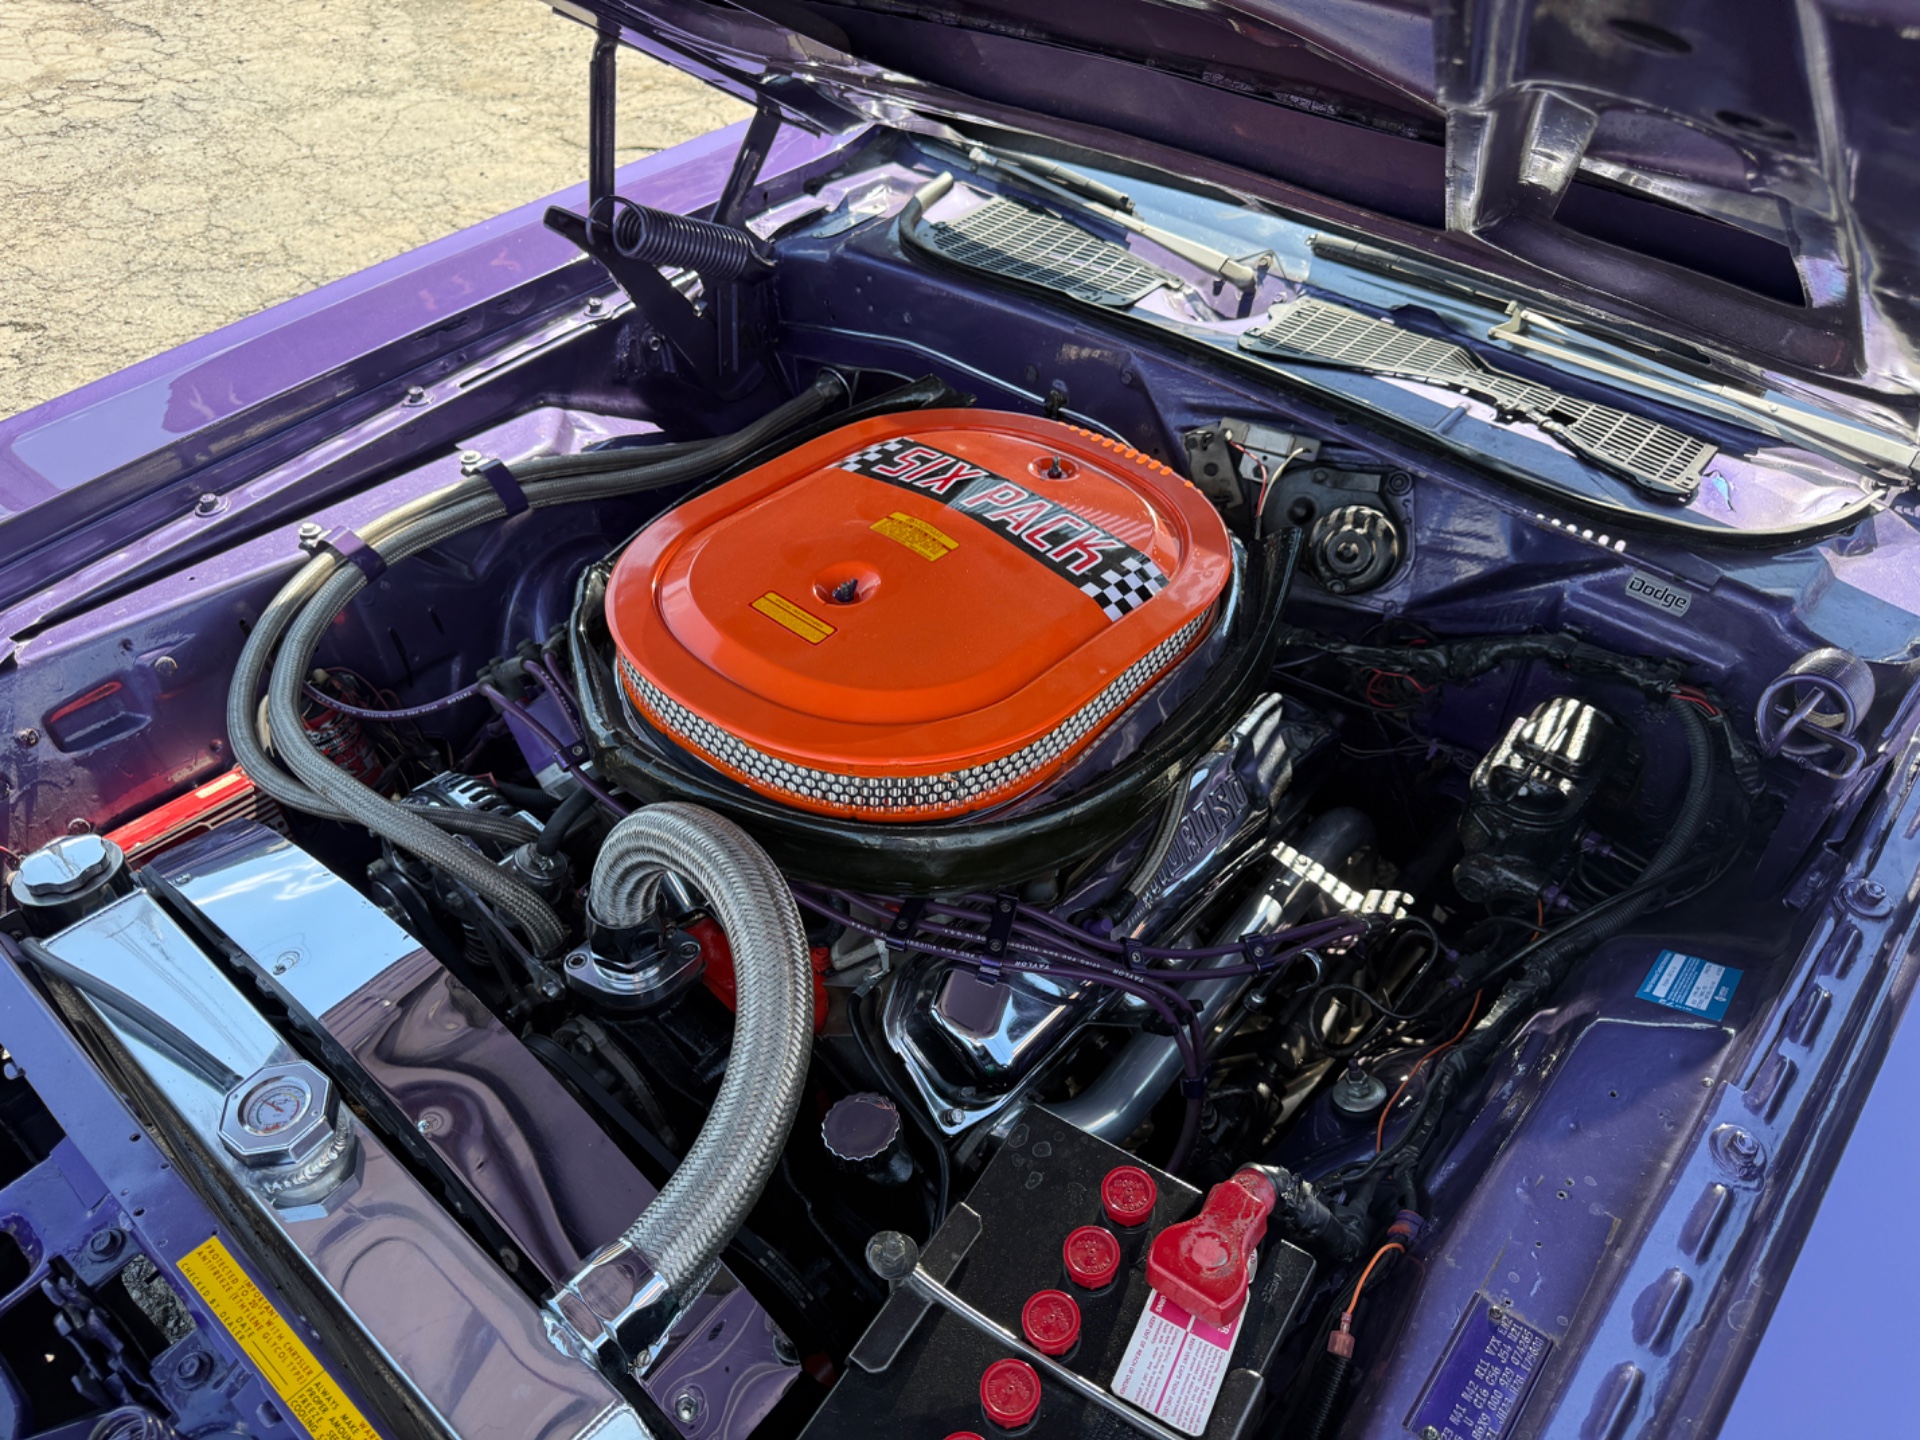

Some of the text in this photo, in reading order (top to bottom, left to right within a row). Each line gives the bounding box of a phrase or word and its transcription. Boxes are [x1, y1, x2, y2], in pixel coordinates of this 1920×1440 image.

[876, 446, 988, 494] SIX
[960, 482, 1115, 576] PACK
[1628, 576, 1686, 608] Dodge
[1014, 957, 1050, 972] TAYLOR
[1111, 968, 1144, 983] TAYLOR
[179, 1261, 246, 1342] CHECKED BY DEALER
[194, 1249, 307, 1385] ANTIFREEZE (ETHYLENE GLYCOL TYPE)
[203, 1243, 240, 1285] PROTECTED
[264, 1318, 285, 1342] WITH
[281, 1341, 314, 1377] CHRYSLER
[241, 1278, 279, 1321] IMPORTANT
[234, 1315, 255, 1338] DATE
[1483, 1335, 1503, 1357] V7X
[288, 1398, 319, 1433] COOLING
[295, 1392, 327, 1427] FREEZE.
[304, 1386, 329, 1414] PROPER
[312, 1380, 360, 1435] ALWAYS MAKE
[1462, 1415, 1475, 1427] U
